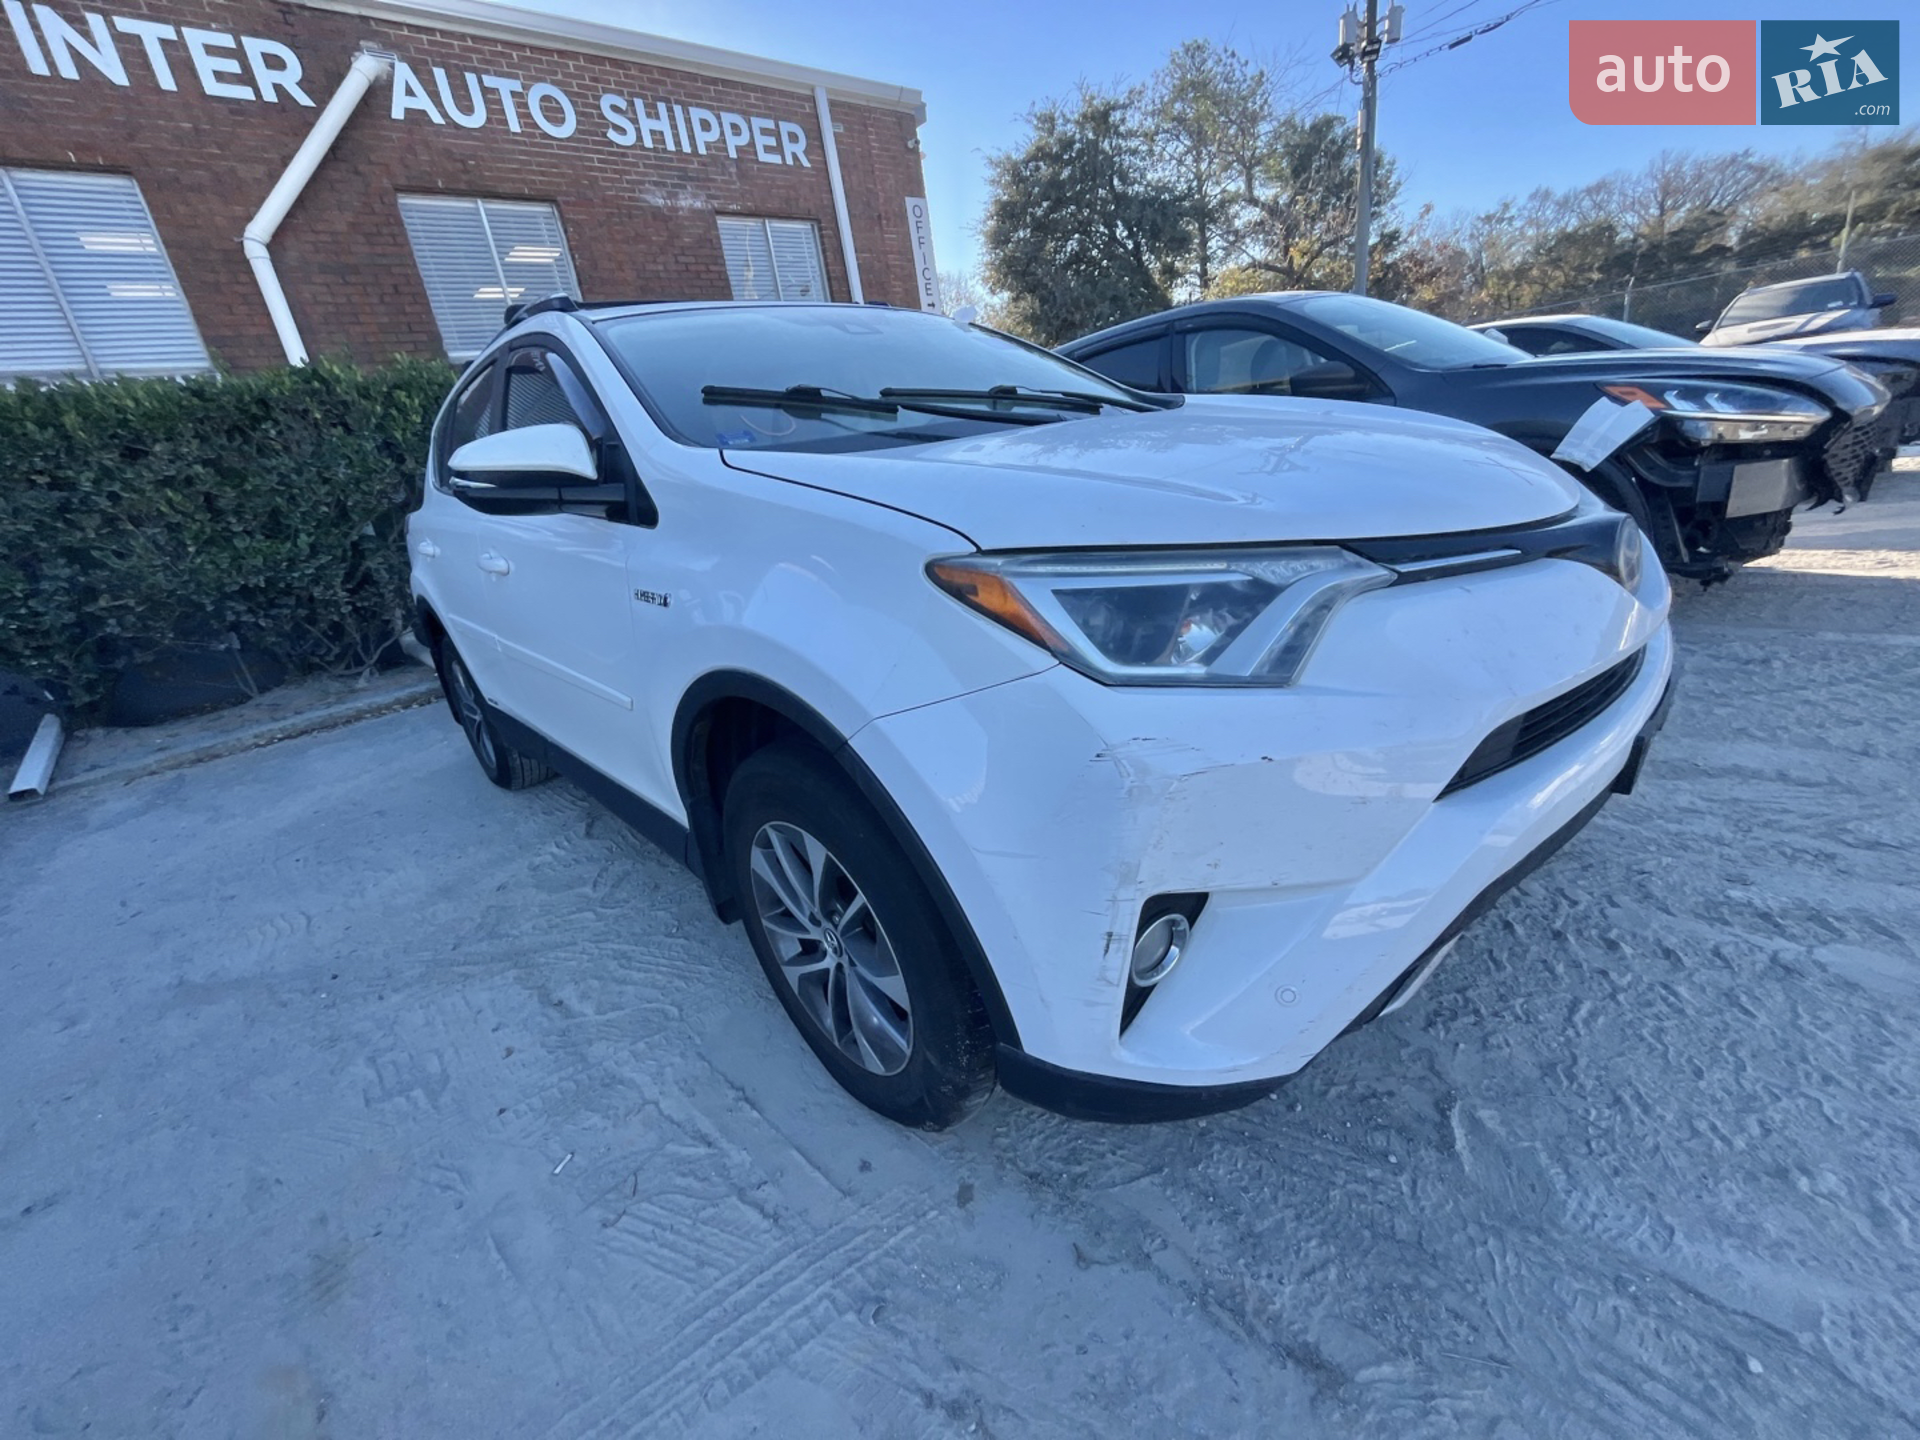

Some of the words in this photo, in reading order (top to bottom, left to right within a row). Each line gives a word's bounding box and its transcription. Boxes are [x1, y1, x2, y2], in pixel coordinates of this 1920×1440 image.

[2, 0, 316, 107] INTER
[391, 61, 577, 139] AUTO
[600, 93, 811, 168] SHIPPER
[912, 204, 934, 297] OFFICE
